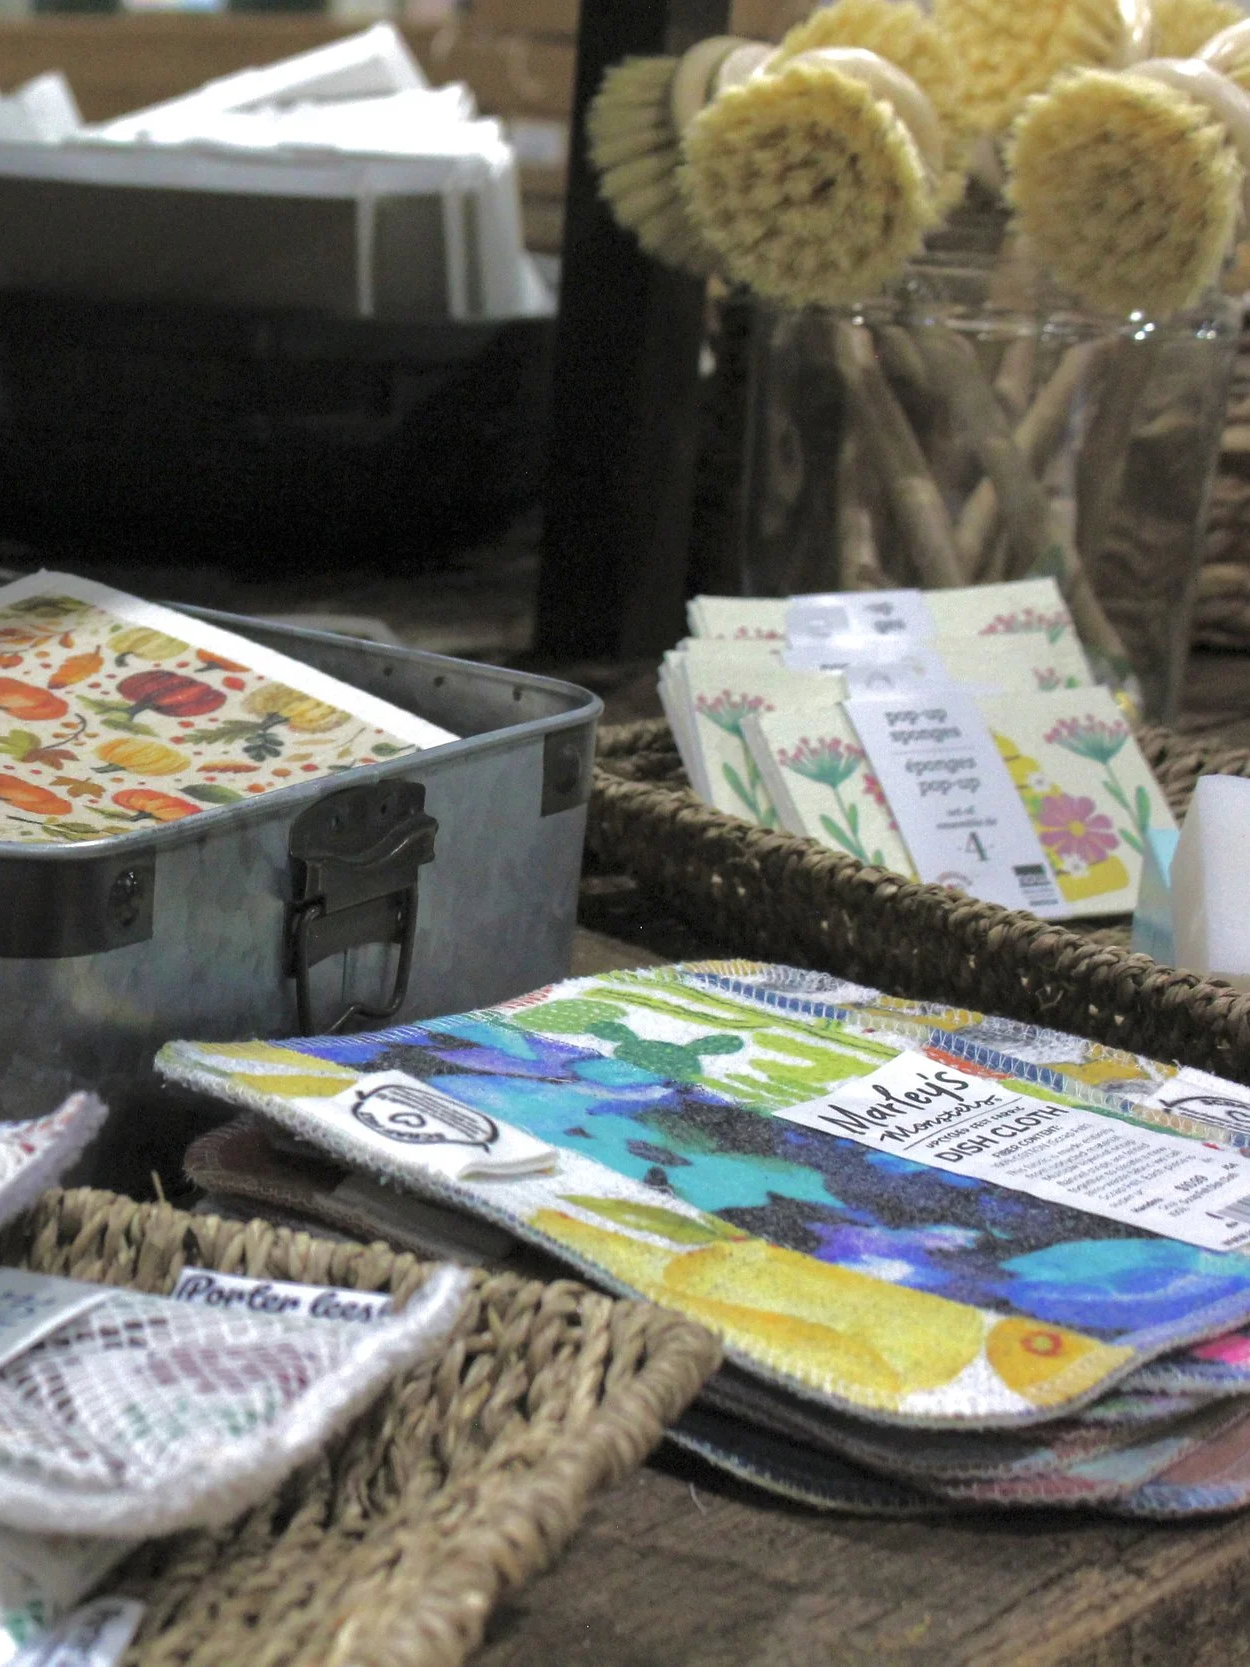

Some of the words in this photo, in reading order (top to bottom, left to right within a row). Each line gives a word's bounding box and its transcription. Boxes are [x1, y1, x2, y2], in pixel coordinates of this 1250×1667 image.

[885, 708, 948, 726] pop-up
[891, 727, 961, 745] sponges
[919, 777, 981, 797] pop-up
[817, 1071, 969, 1135] Marley's
[934, 1134, 999, 1163] DISH
[991, 1105, 1069, 1139] CLOTH
[991, 1144, 1021, 1159] FIBER
[177, 1274, 300, 1314] Porter
